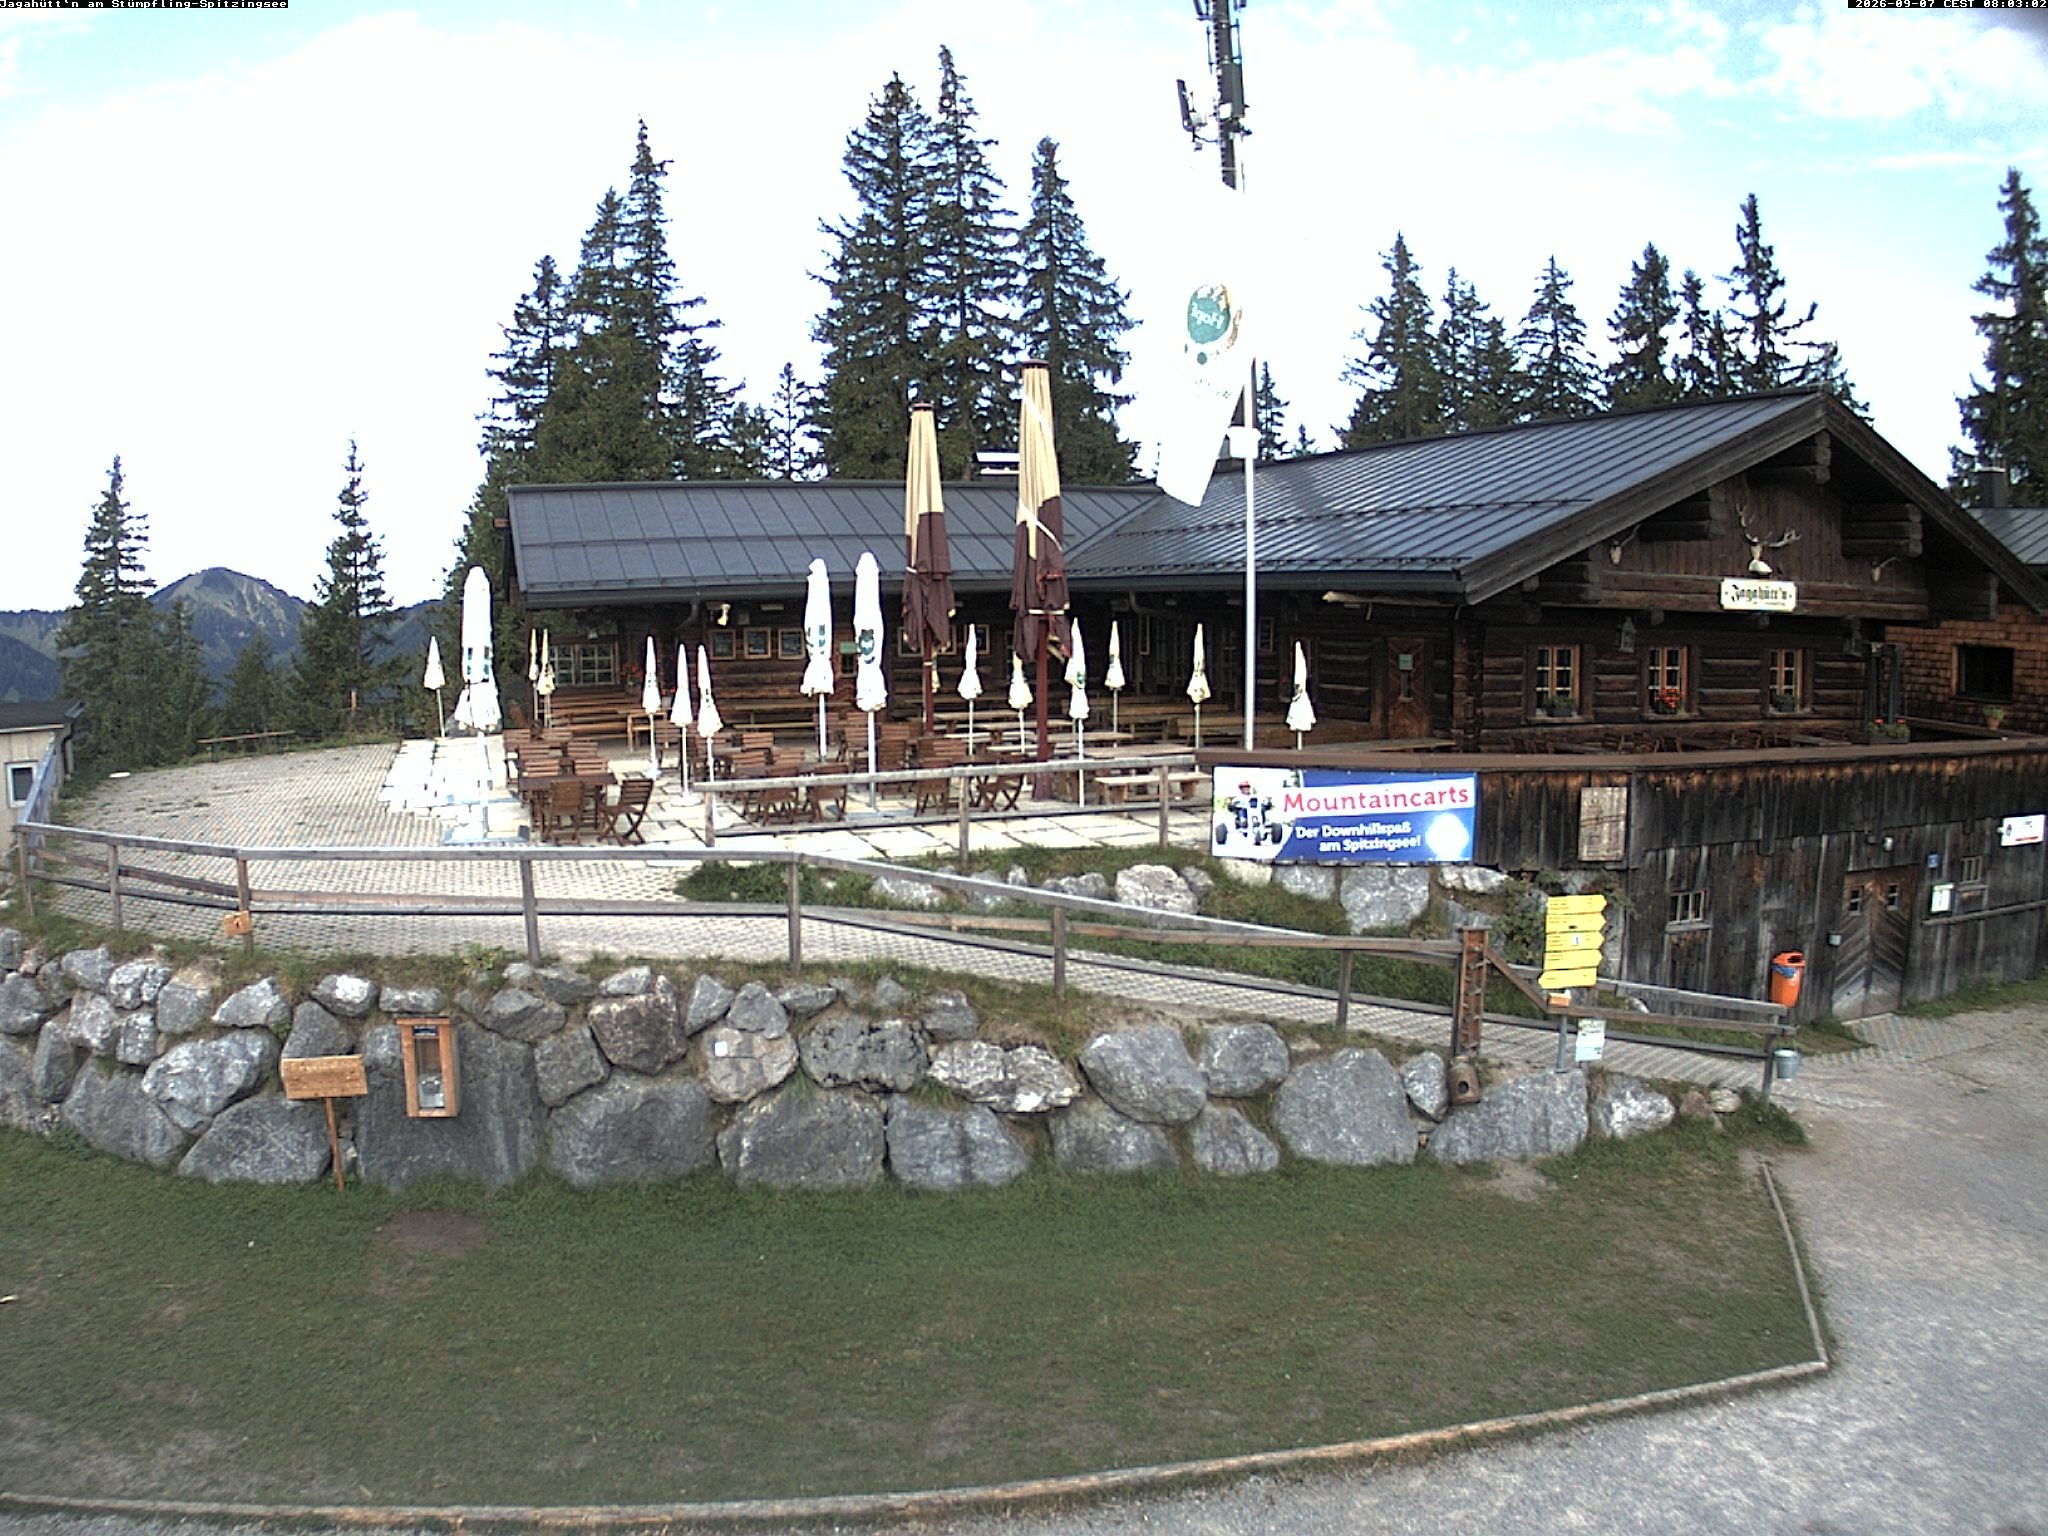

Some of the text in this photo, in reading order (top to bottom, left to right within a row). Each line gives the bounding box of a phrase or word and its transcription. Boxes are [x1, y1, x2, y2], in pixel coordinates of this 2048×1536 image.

[1284, 787, 1468, 812] Mountaincarts
[1296, 821, 1411, 839] Der Downhillspaß
[1319, 835, 1421, 853] am Spitzingsee!
